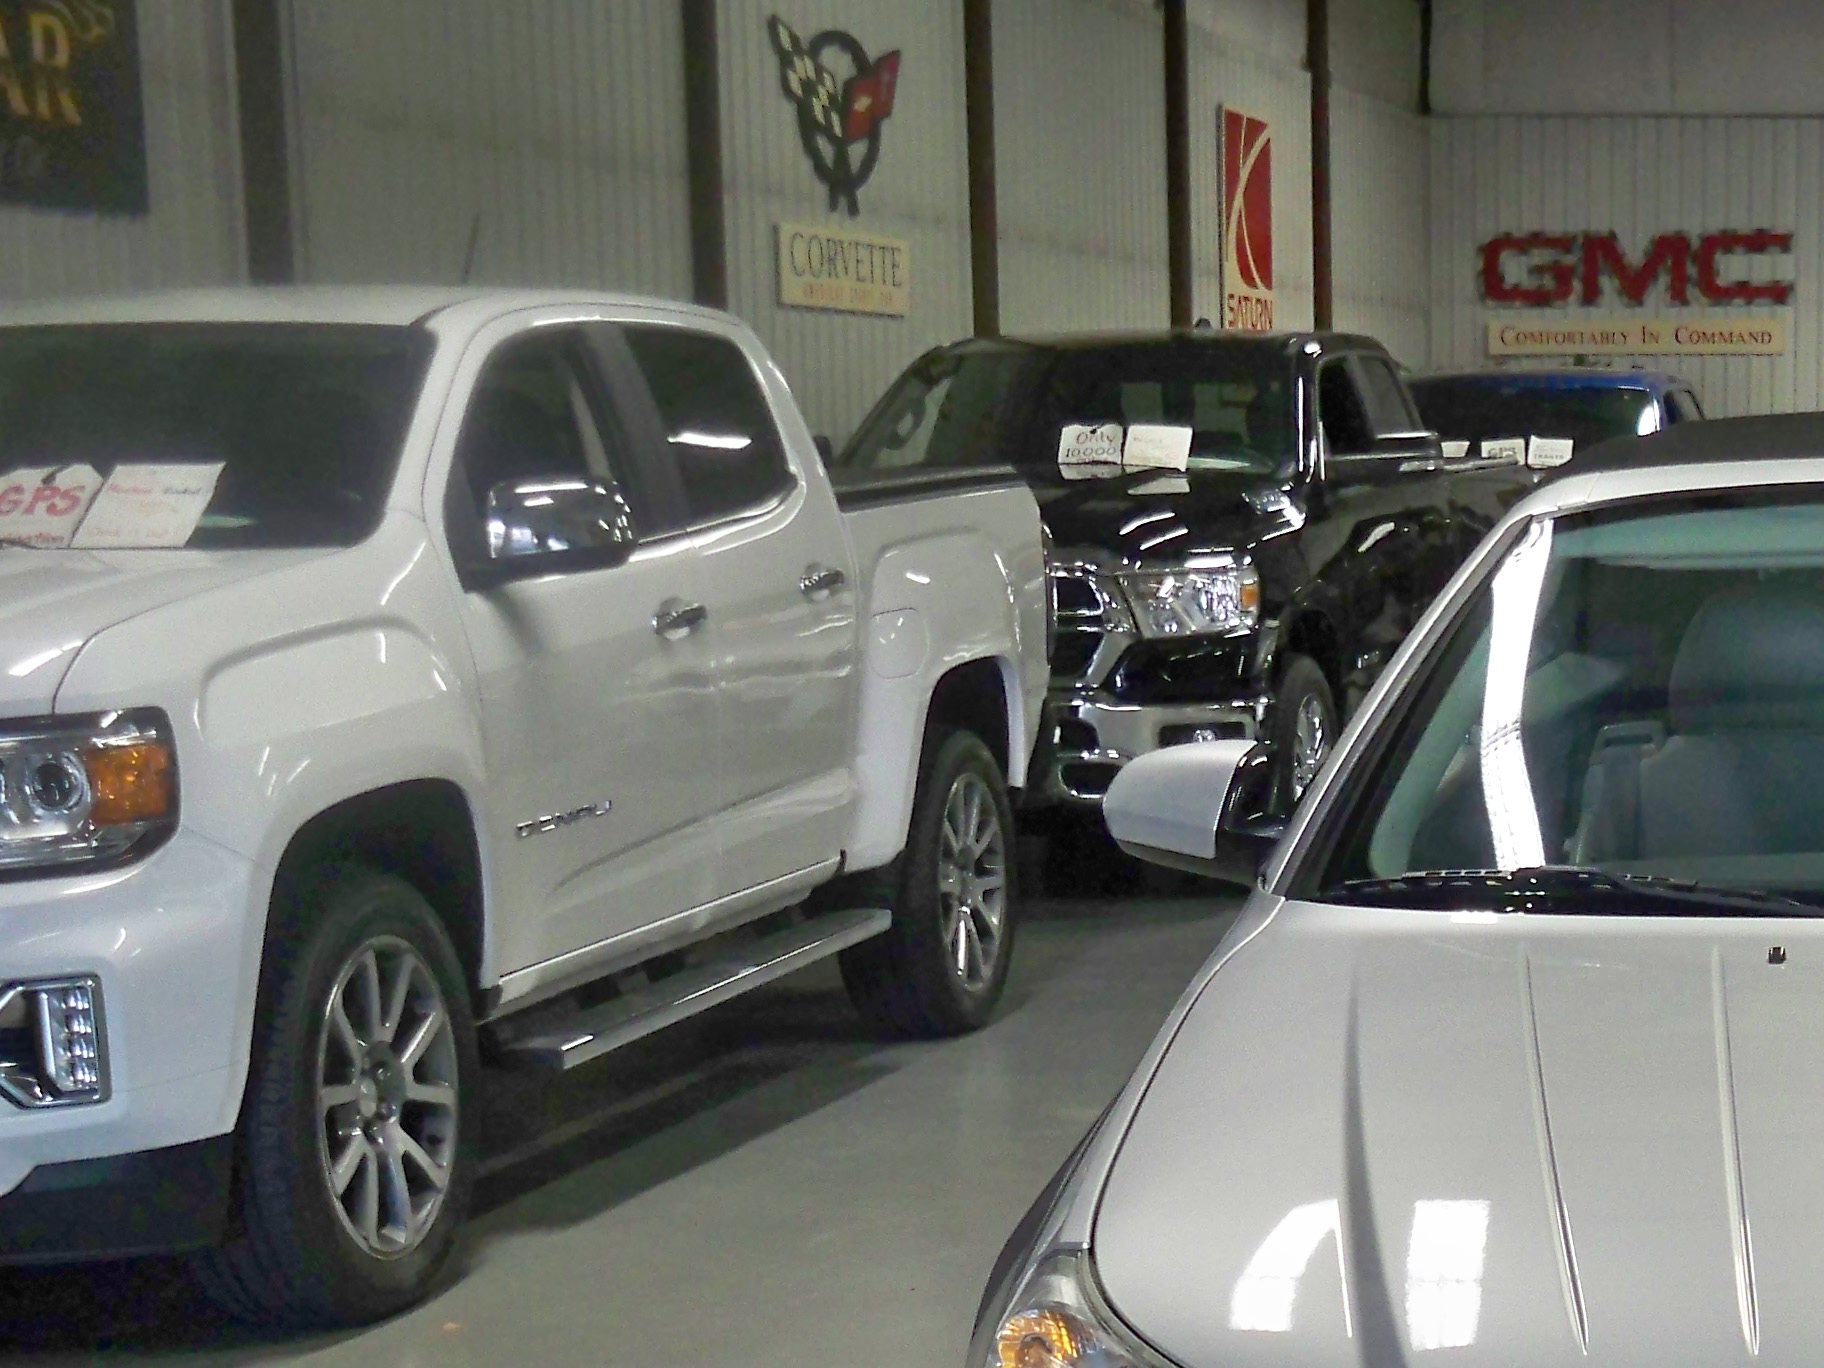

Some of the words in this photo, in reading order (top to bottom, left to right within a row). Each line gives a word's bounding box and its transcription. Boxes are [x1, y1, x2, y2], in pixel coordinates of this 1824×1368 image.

[790, 231, 902, 288] CORVETTE
[1482, 230, 1793, 307] GMC
[1227, 293, 1273, 330] SATURN
[1674, 326, 1773, 346] COMMAND
[0, 484, 86, 517] GPS
